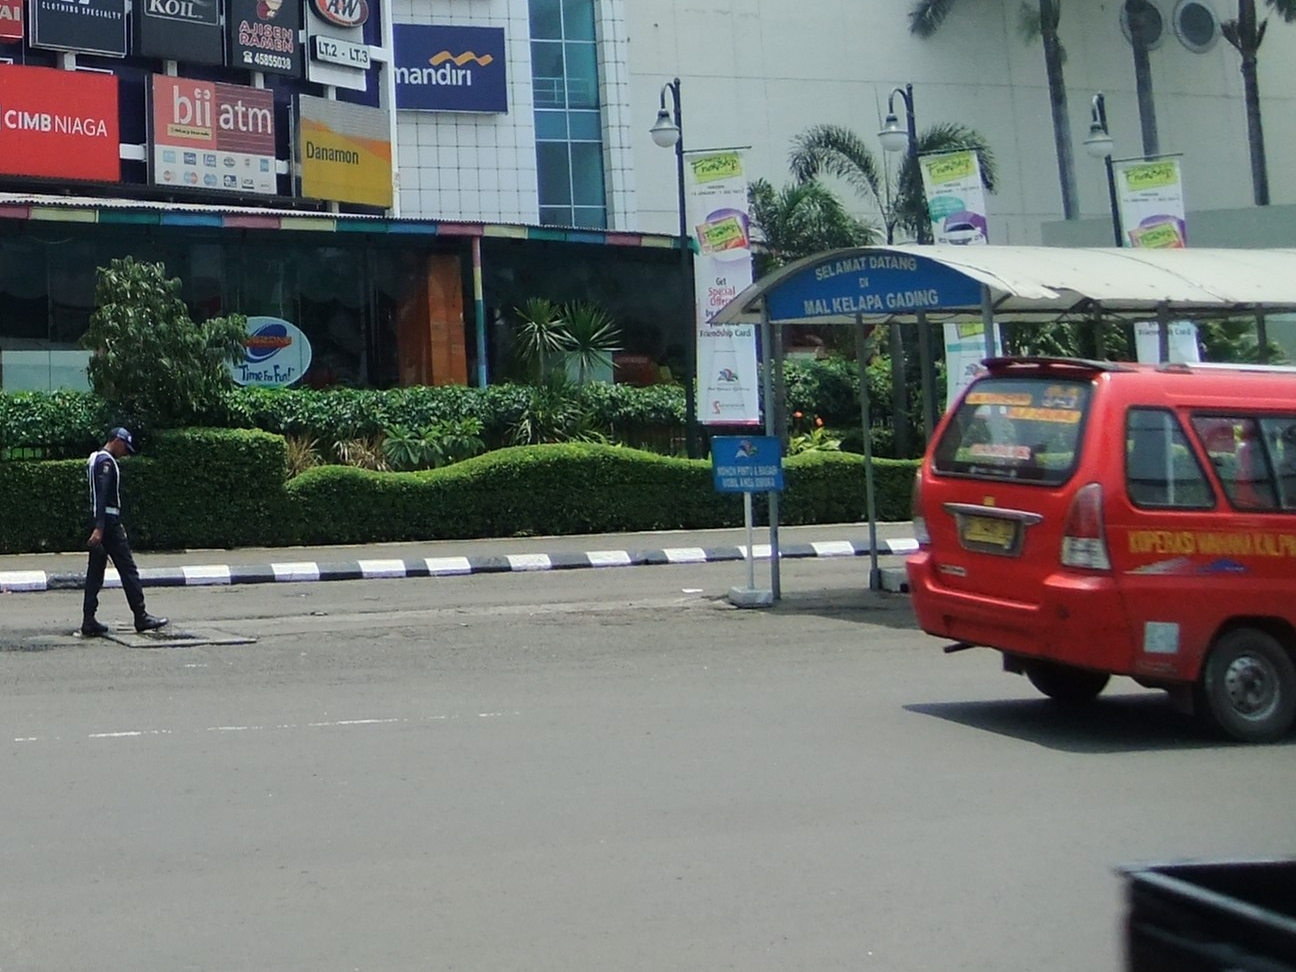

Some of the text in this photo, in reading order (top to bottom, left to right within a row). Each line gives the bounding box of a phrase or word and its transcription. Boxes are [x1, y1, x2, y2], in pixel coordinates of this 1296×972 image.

[42, 1, 122, 20] CLOTHING SPECIALTY
[239, 20, 294, 40] AJISEN
[239, 32, 294, 54] RAMEN
[318, 41, 338, 58] LT.2
[349, 48, 368, 63] LT.3
[394, 62, 472, 86] mandiri
[173, 85, 272, 134] bii atm
[306, 141, 360, 165] Danamon
[815, 256, 917, 281] SELAMAT DATANG
[716, 278, 727, 286] Get
[804, 289, 939, 315] MAL KELAPA GADING
